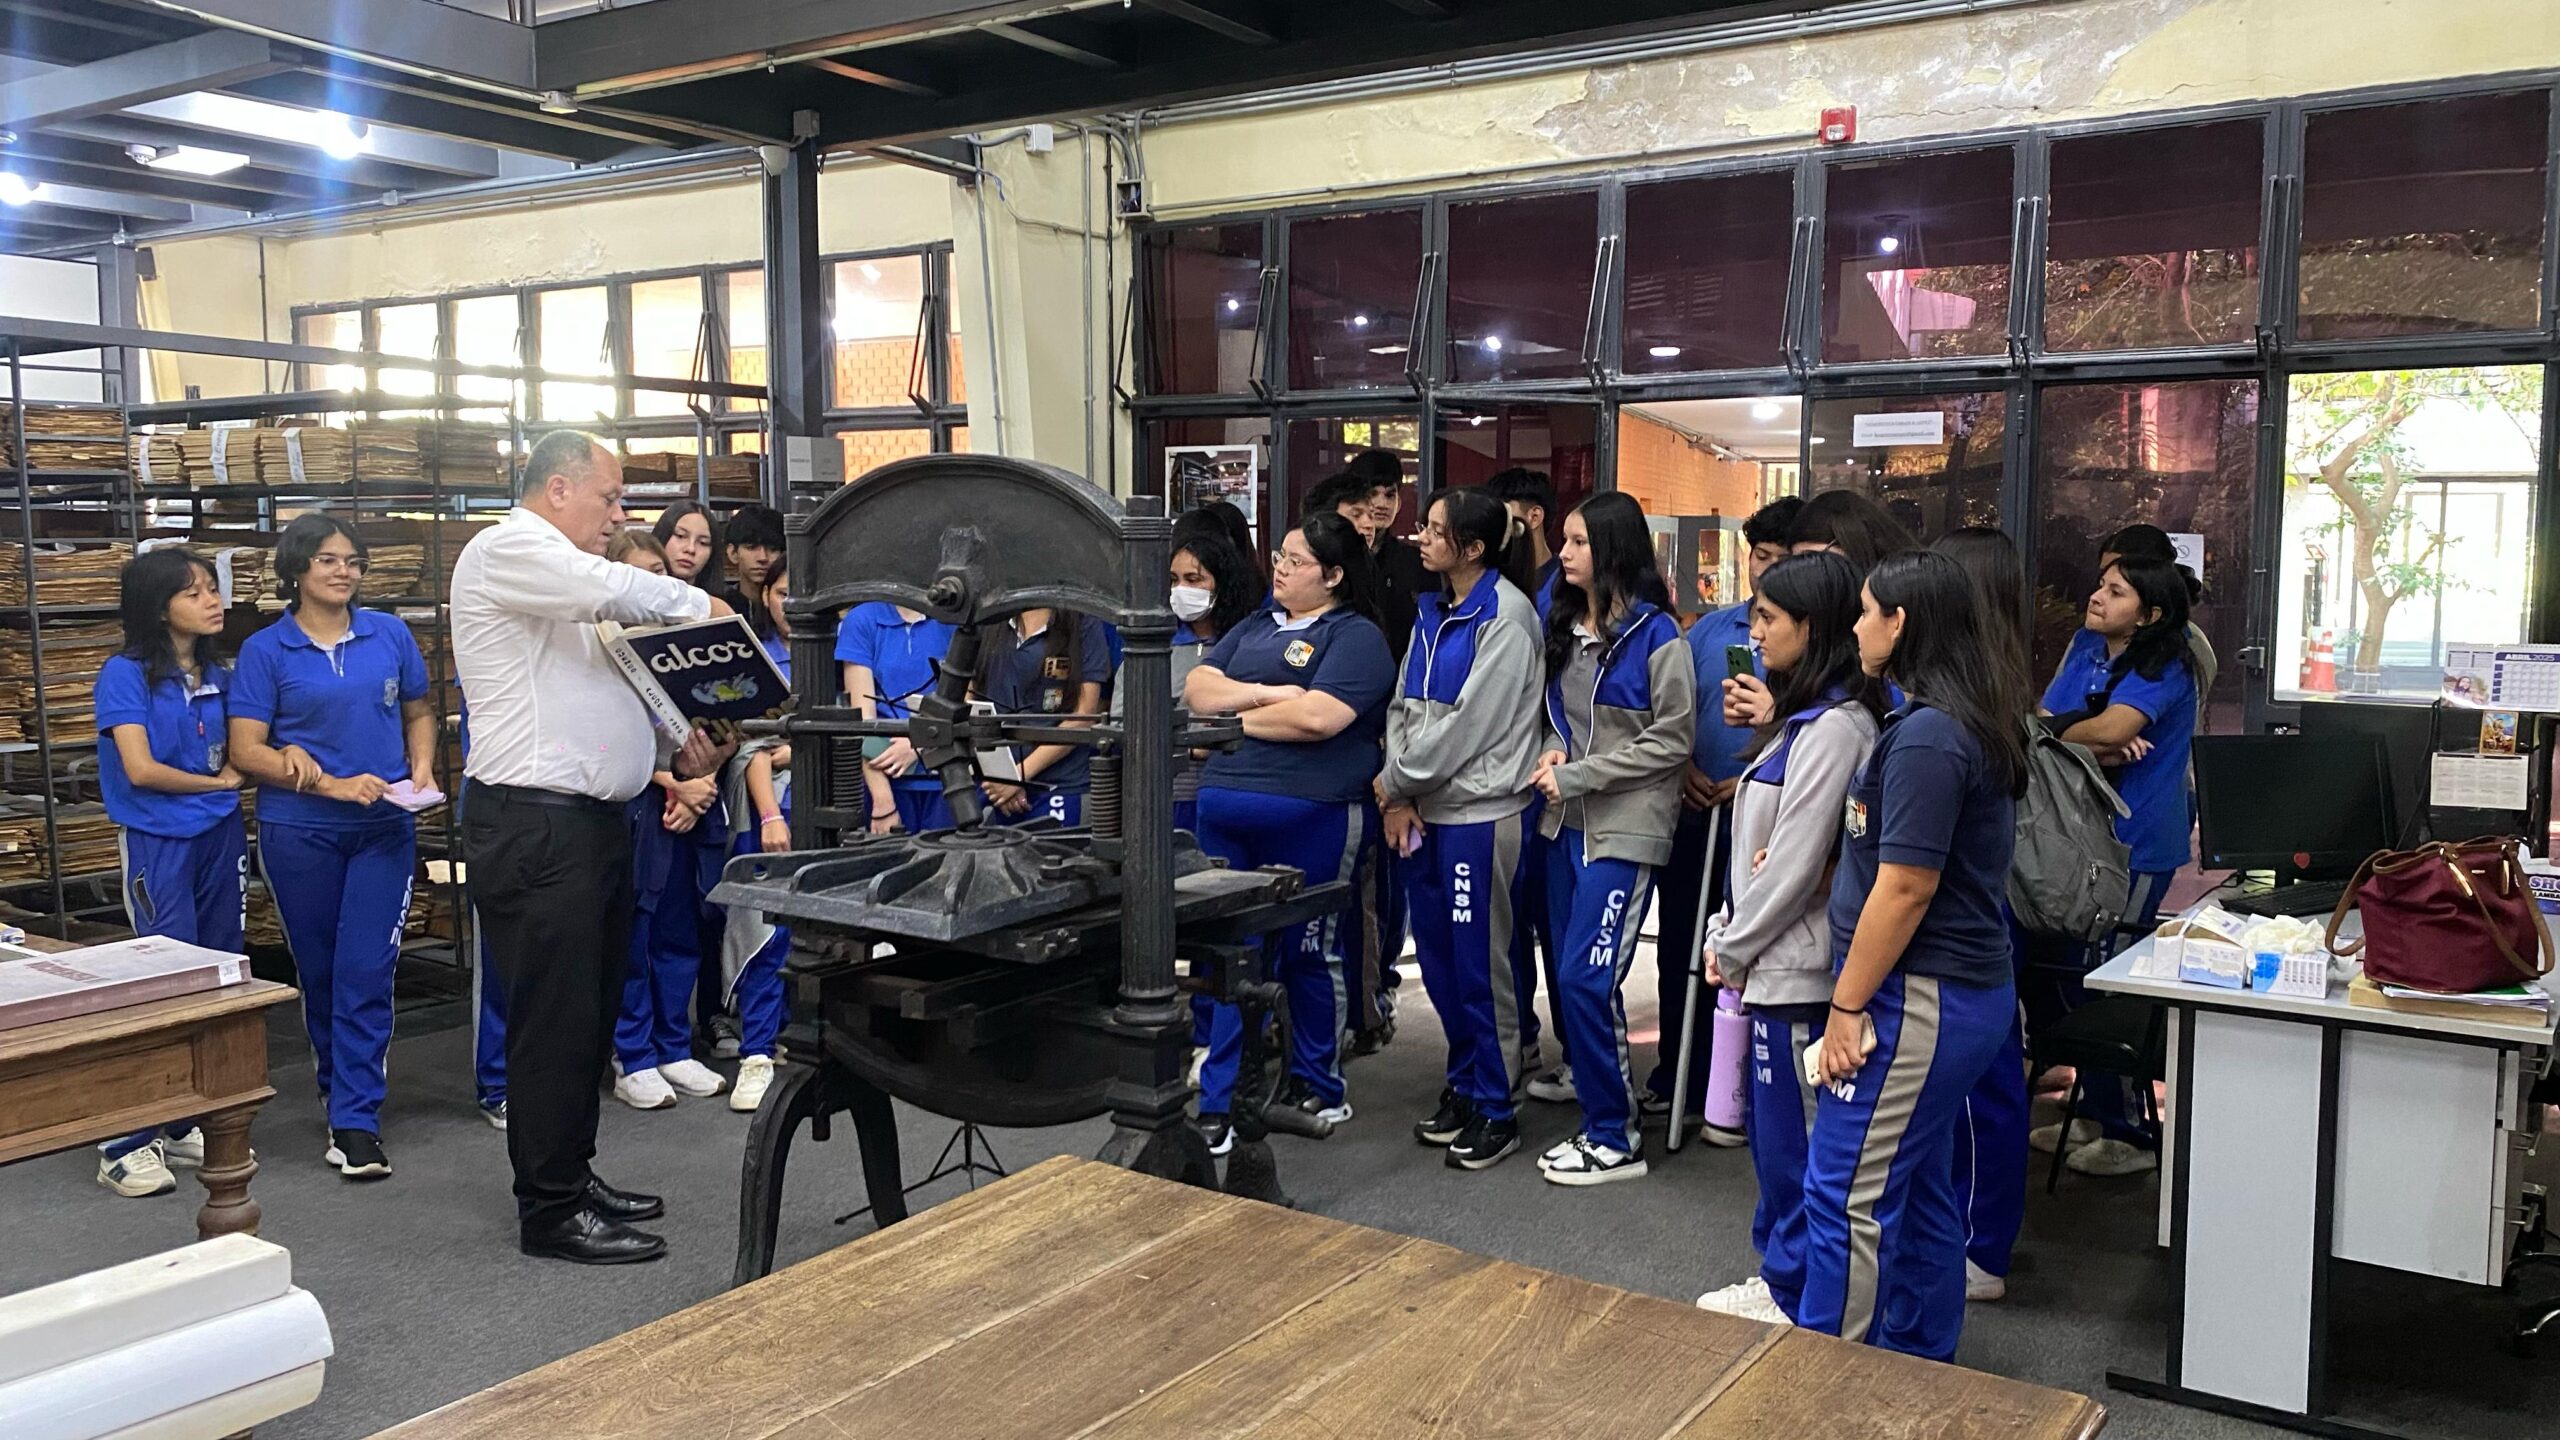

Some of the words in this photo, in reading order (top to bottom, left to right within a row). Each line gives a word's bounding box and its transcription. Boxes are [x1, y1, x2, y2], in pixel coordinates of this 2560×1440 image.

[651, 640, 753, 673] alcor
[1049, 795, 1065, 821] CN
[1452, 862, 1472, 923] CNSM
[1300, 919, 1320, 953] SM
[1589, 889, 1625, 967] CNSM
[1754, 1020, 1772, 1085] NSM
